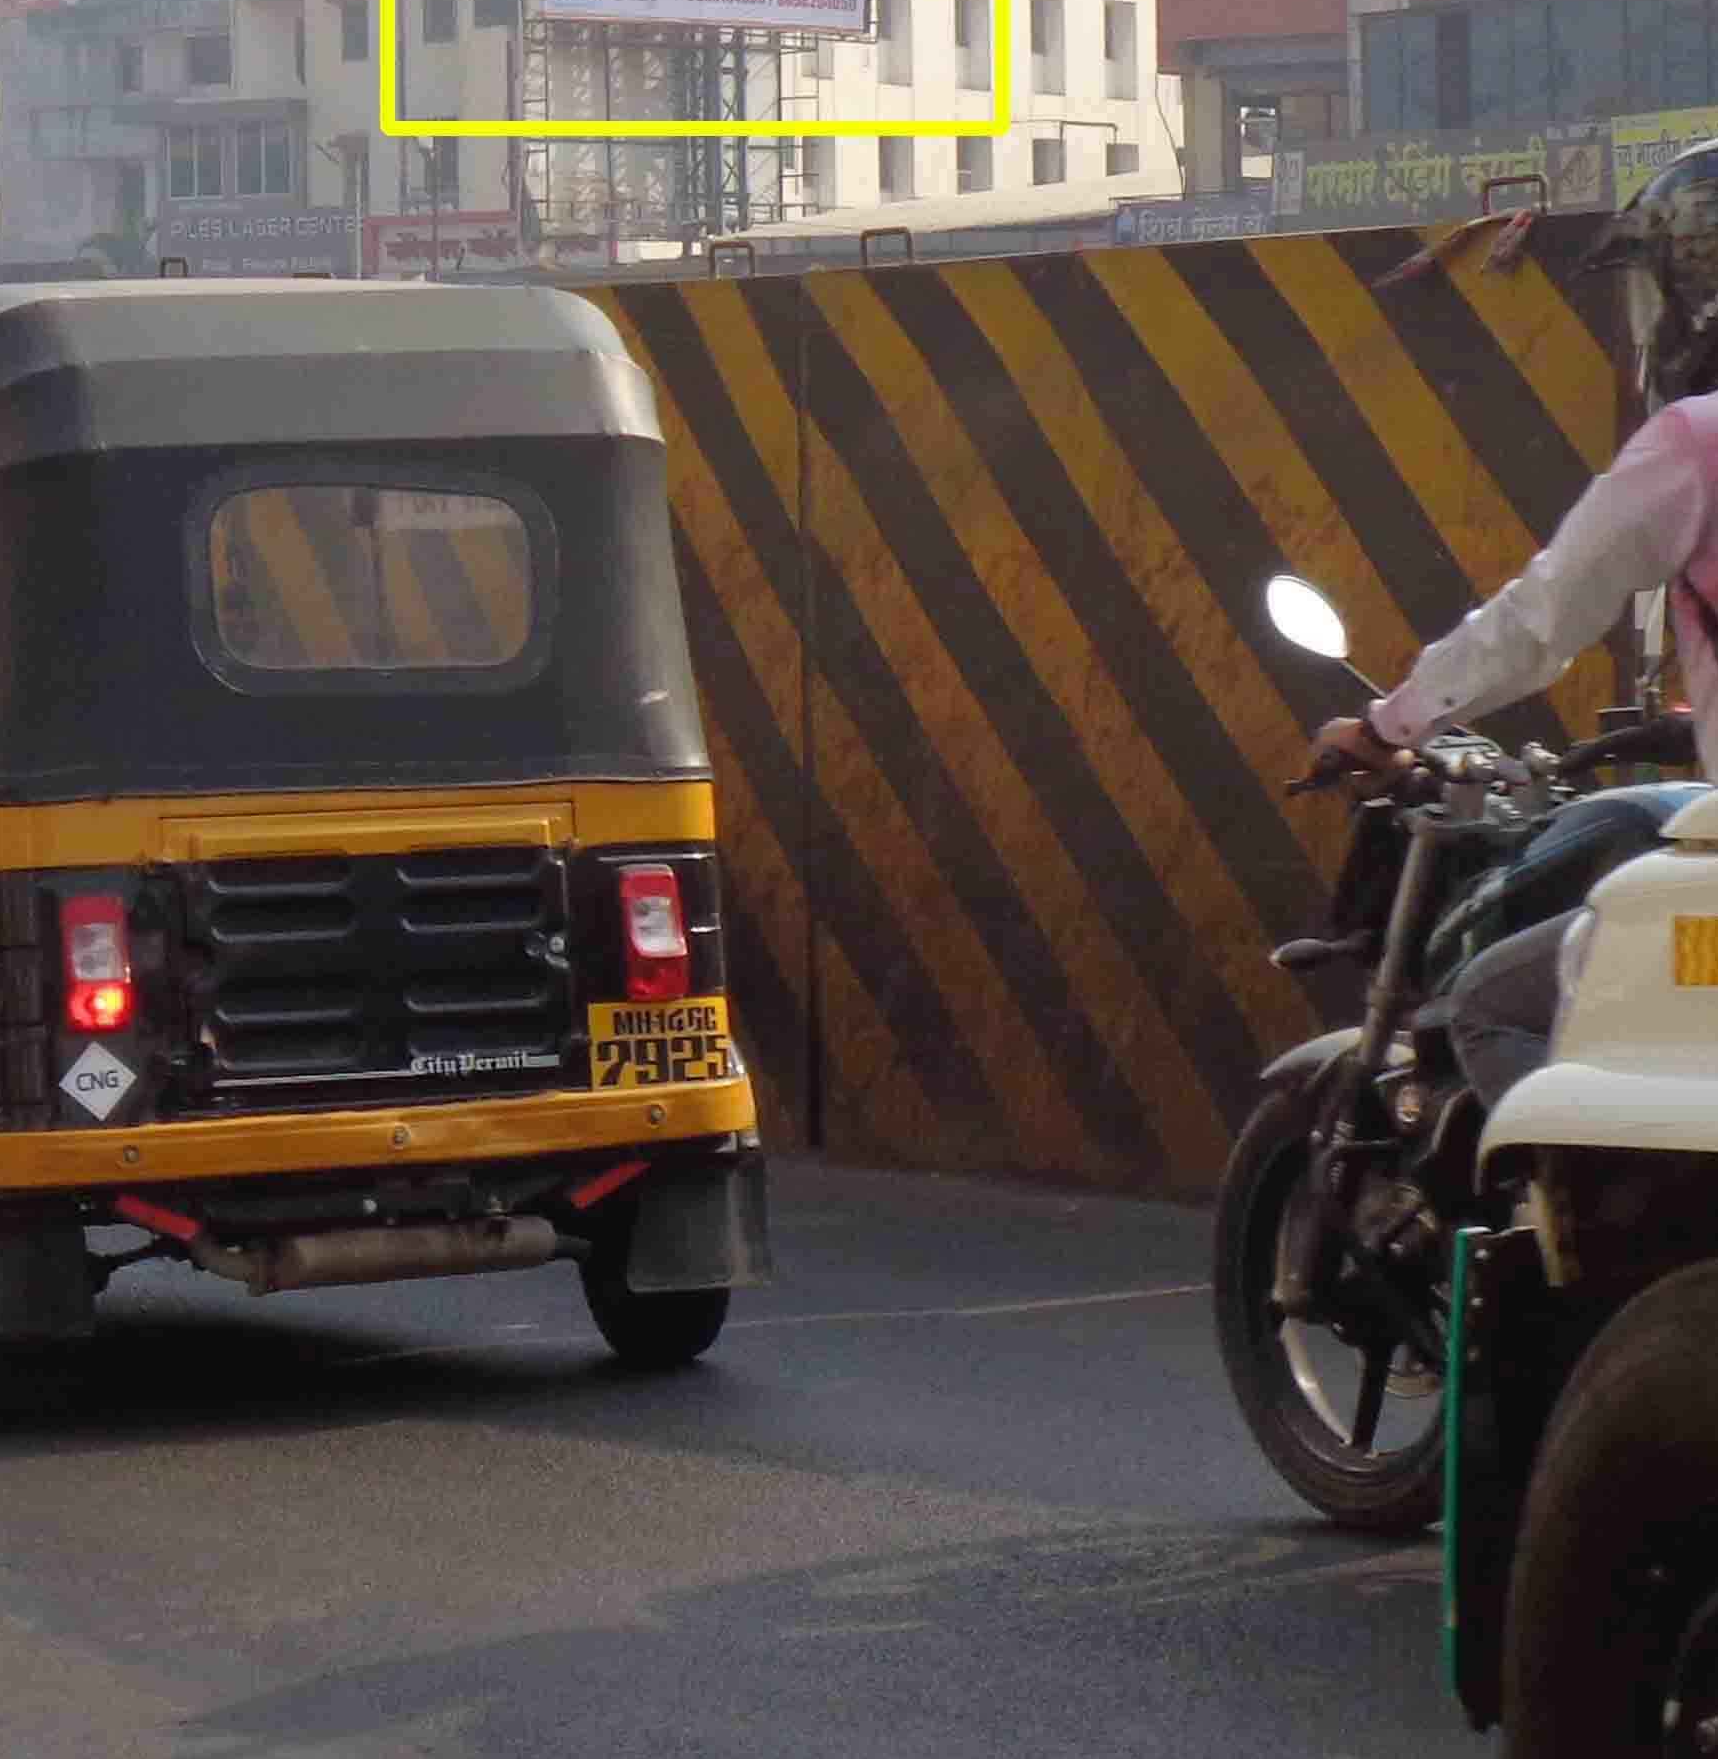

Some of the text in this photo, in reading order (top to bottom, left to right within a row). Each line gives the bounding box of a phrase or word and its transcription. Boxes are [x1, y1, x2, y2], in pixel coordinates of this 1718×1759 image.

[294, 212, 363, 235] CENTE
[595, 1036, 727, 1090] 7925
[76, 1070, 120, 1092] CNG
